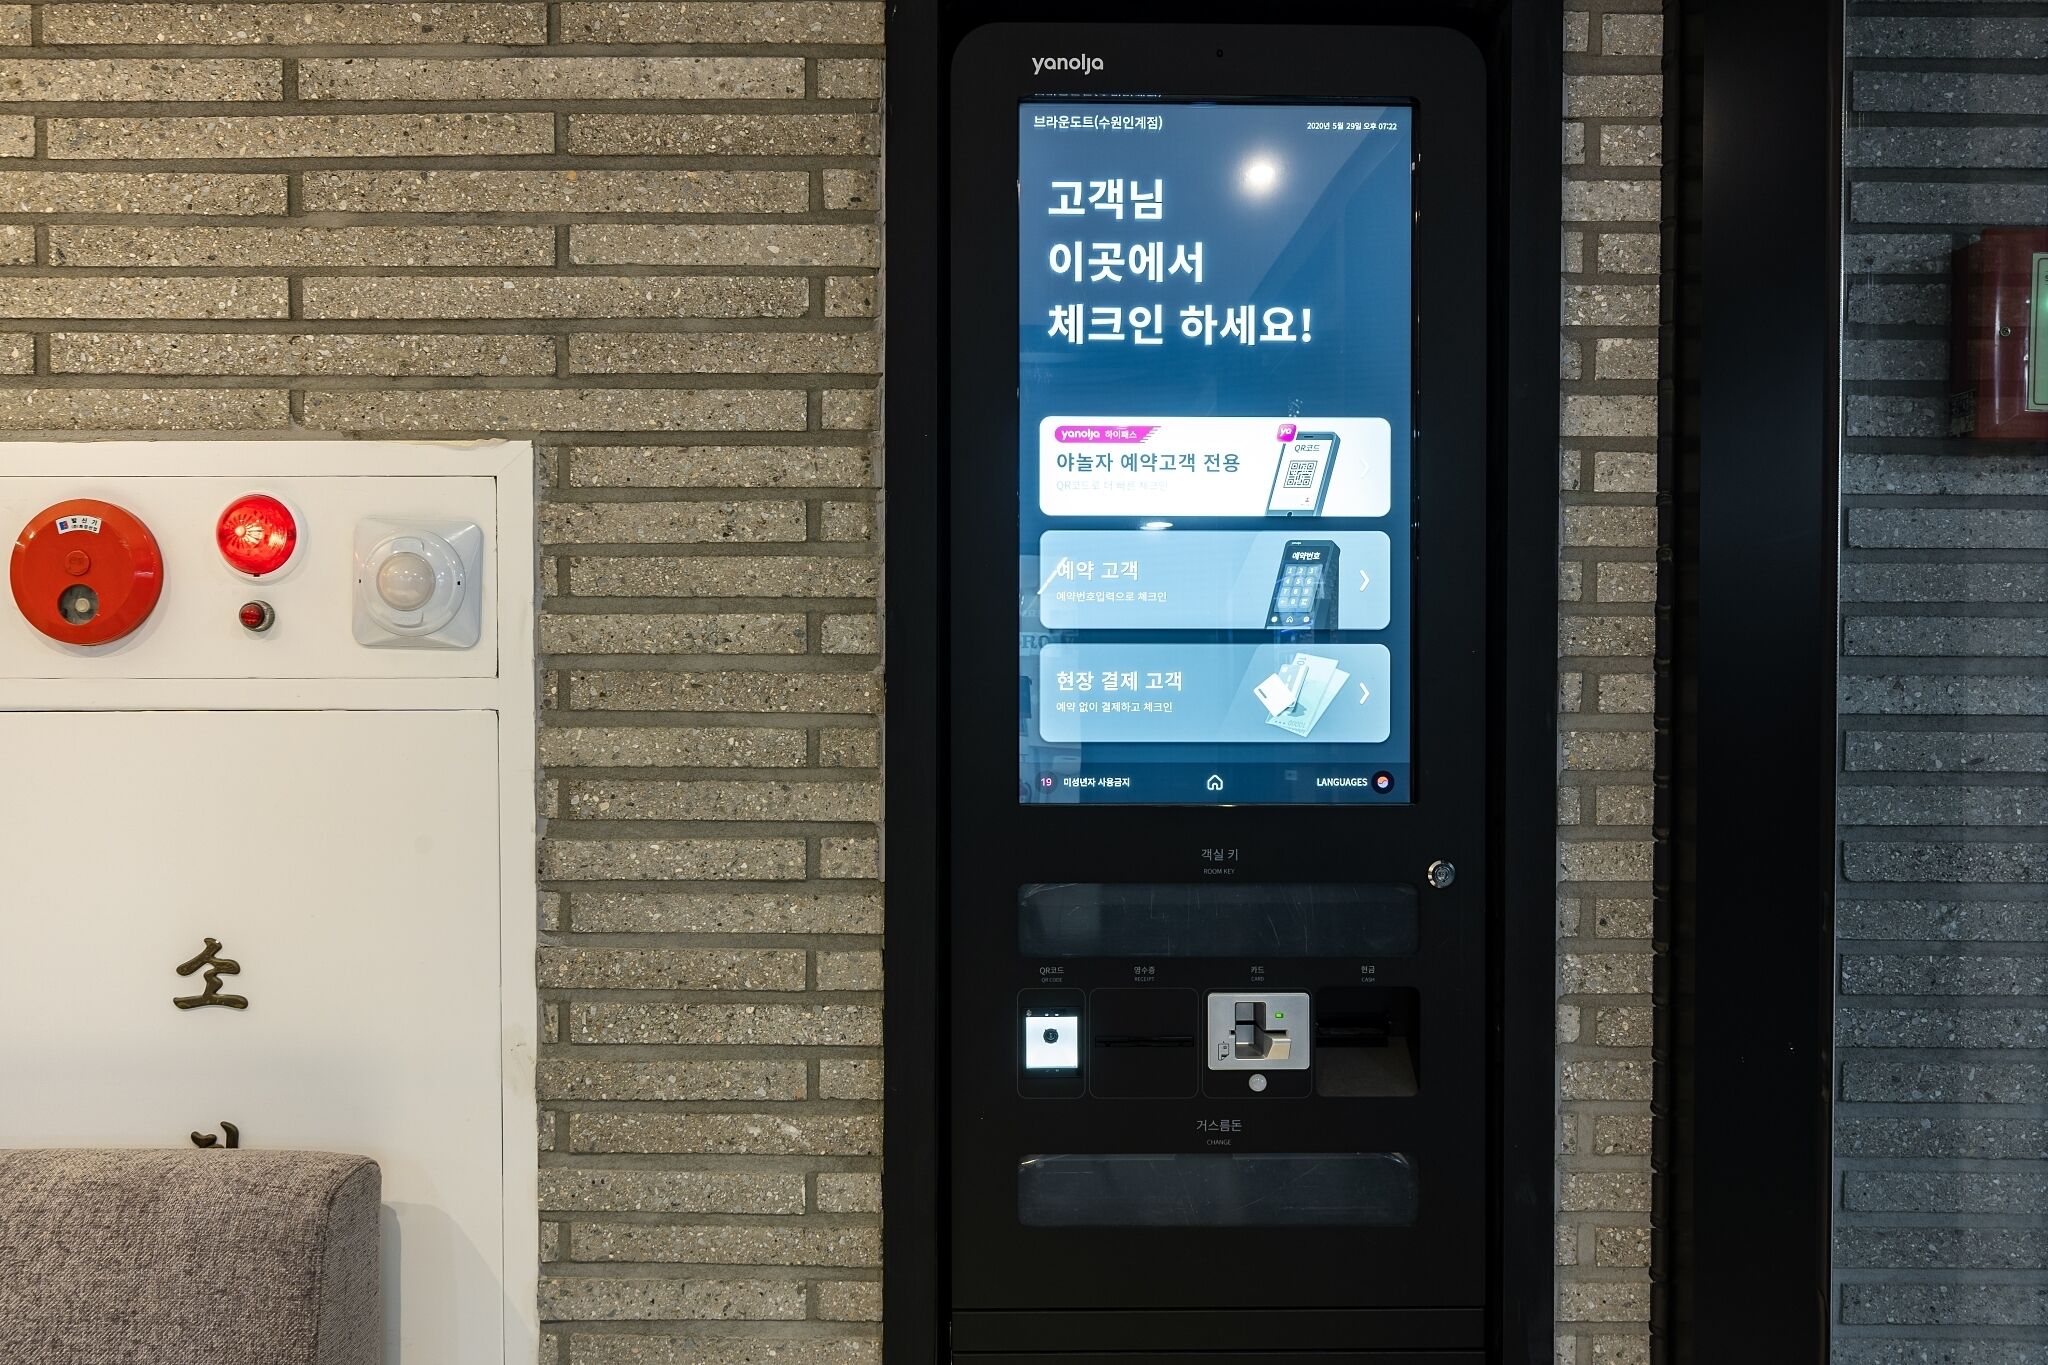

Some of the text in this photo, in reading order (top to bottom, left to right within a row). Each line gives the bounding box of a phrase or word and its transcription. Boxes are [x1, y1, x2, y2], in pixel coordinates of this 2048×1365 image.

[1032, 53, 1104, 75] yanolja
[1033, 114, 1163, 131] 브라운도트(수원인계점)
[1307, 122, 1330, 130] 2020년
[1333, 122, 1343, 130] 5월
[1346, 122, 1361, 130] 29일
[1047, 178, 1164, 220] 고객님
[1048, 241, 1204, 283] 이곳에서
[1047, 304, 1312, 345] 체크인 하세요!
[1061, 429, 1137, 440] yanolja 하이패스
[1295, 445, 1320, 453] QR코드
[1057, 452, 1240, 472] 야놀자 예약고객 전용
[1292, 552, 1321, 560] 예약번호
[1056, 560, 1139, 581] 예약 고객
[1056, 591, 1167, 603] 예약번호입력으로 체크인
[1056, 671, 1182, 691] 현장 결제 고객
[1056, 701, 1173, 713] 예약 없이 결제하고 체크인
[1041, 778, 1052, 786] 19
[1064, 778, 1130, 787] 미성년자 사용금지
[1316, 777, 1368, 787] LANGUAGES
[1201, 849, 1238, 861] 객실 키
[1039, 966, 1064, 975] QR코드
[1133, 966, 1155, 975] 영수증
[1250, 966, 1264, 974] 카드
[1361, 965, 1375, 974] 현금
[1197, 1119, 1242, 1132] 거스름돈
